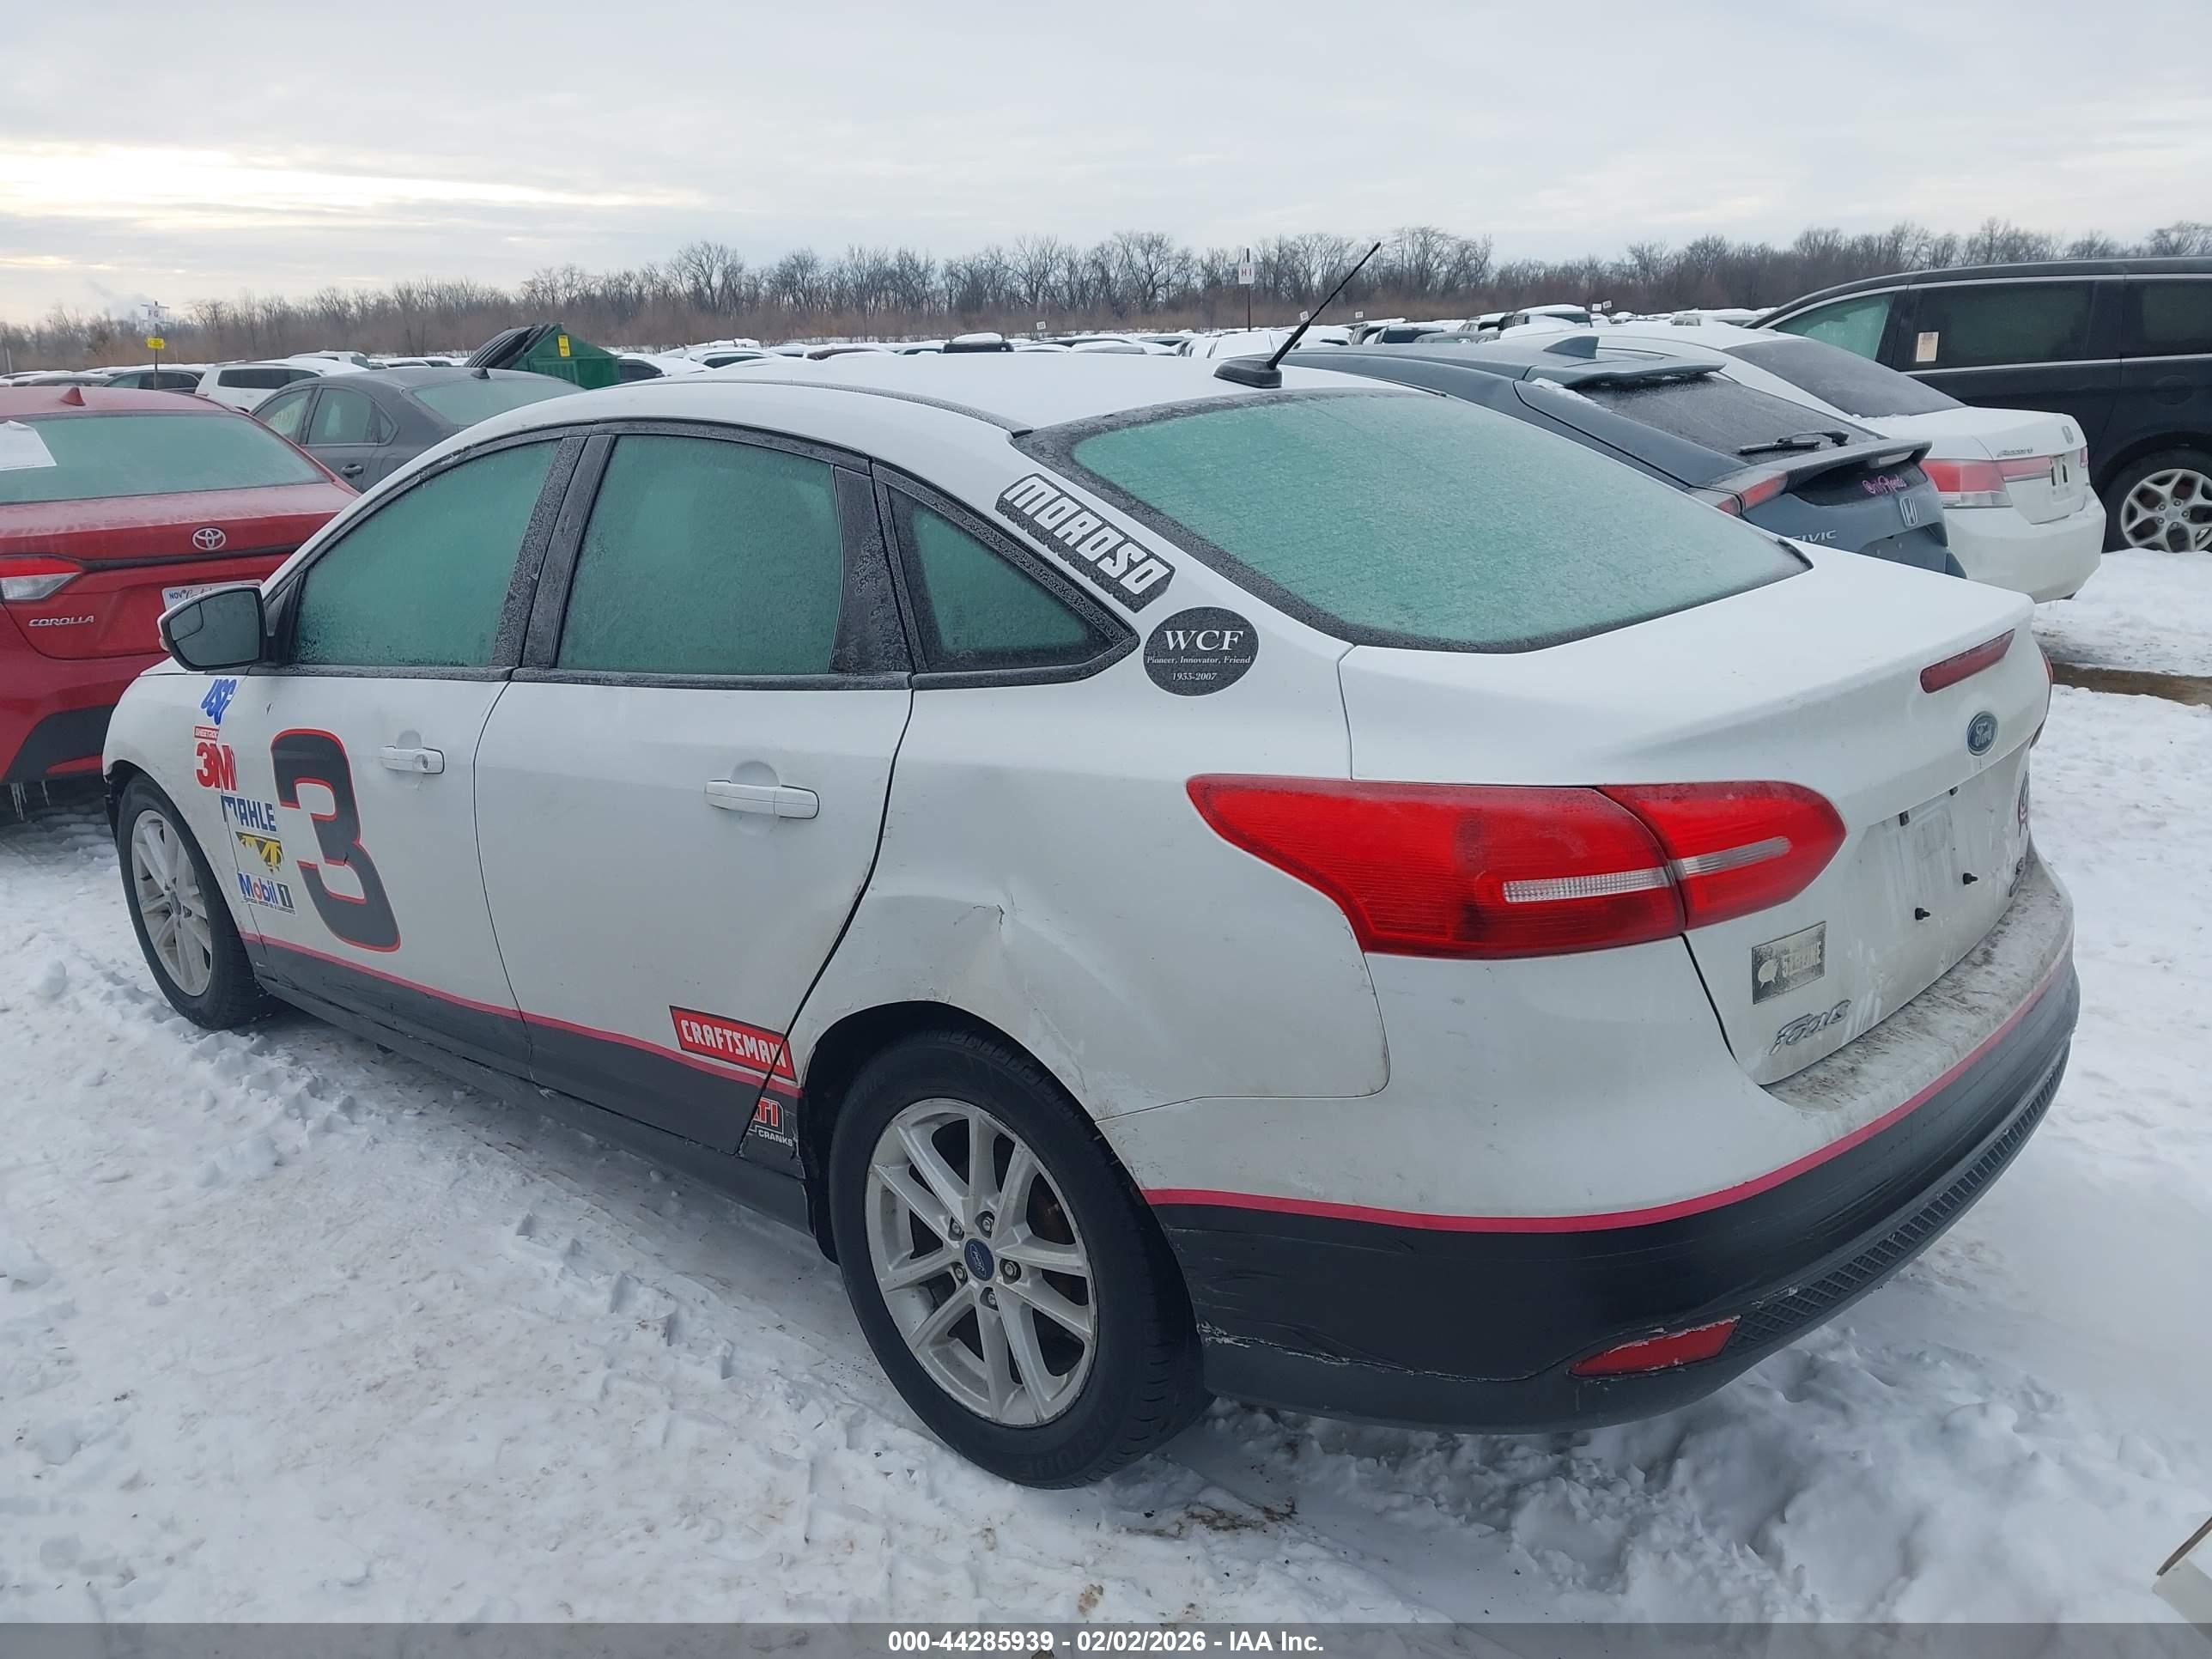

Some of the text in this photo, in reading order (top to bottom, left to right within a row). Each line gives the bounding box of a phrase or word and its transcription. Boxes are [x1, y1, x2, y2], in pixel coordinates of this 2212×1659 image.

[1002, 476, 1171, 595] MOROSO
[28, 615, 94, 627] COROLLA
[1164, 629, 1244, 651] WCF
[1180, 655, 1221, 664] Innovator,
[1224, 655, 1251, 664] Friend
[1975, 722, 1992, 747] Ford
[196, 741, 237, 791] 3M
[270, 729, 401, 953] 3
[237, 872, 278, 904] Mobil
[277, 884, 294, 908] 1
[680, 1019, 787, 1069] CRAFTSMAN
[1769, 1000, 1852, 1055] Focus
[757, 1128, 793, 1147] CRANKS
